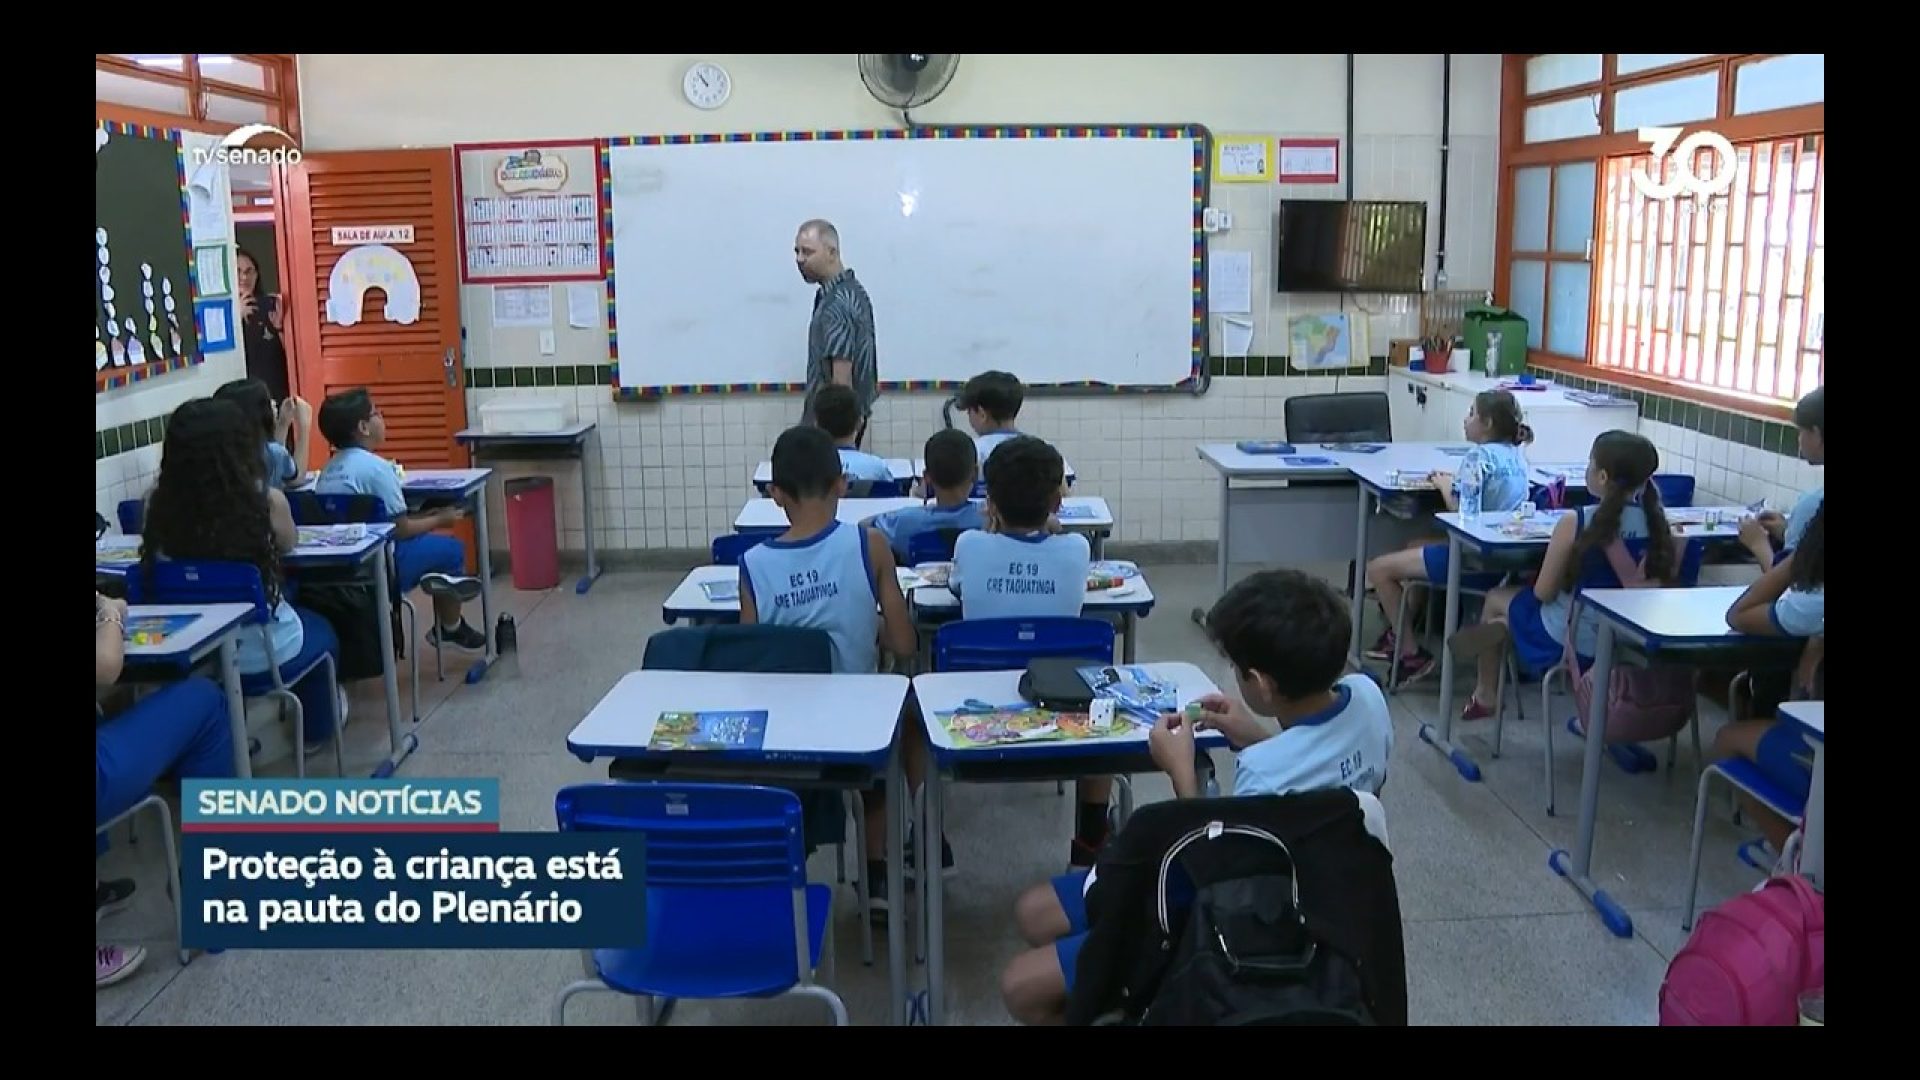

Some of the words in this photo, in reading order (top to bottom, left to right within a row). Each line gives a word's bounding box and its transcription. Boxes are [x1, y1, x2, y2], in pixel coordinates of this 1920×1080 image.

[338, 230, 358, 241] SALA
[360, 230, 370, 240] DE
[398, 228, 409, 239] 12
[1009, 562, 1024, 575] EC
[1027, 563, 1039, 576] 19
[789, 572, 804, 588] EC
[807, 569, 819, 584] 19
[986, 578, 1003, 594] CRE
[1005, 579, 1056, 595] TAGUATINGA
[774, 593, 790, 609] CRE
[790, 581, 838, 607] TAGUATINGA
